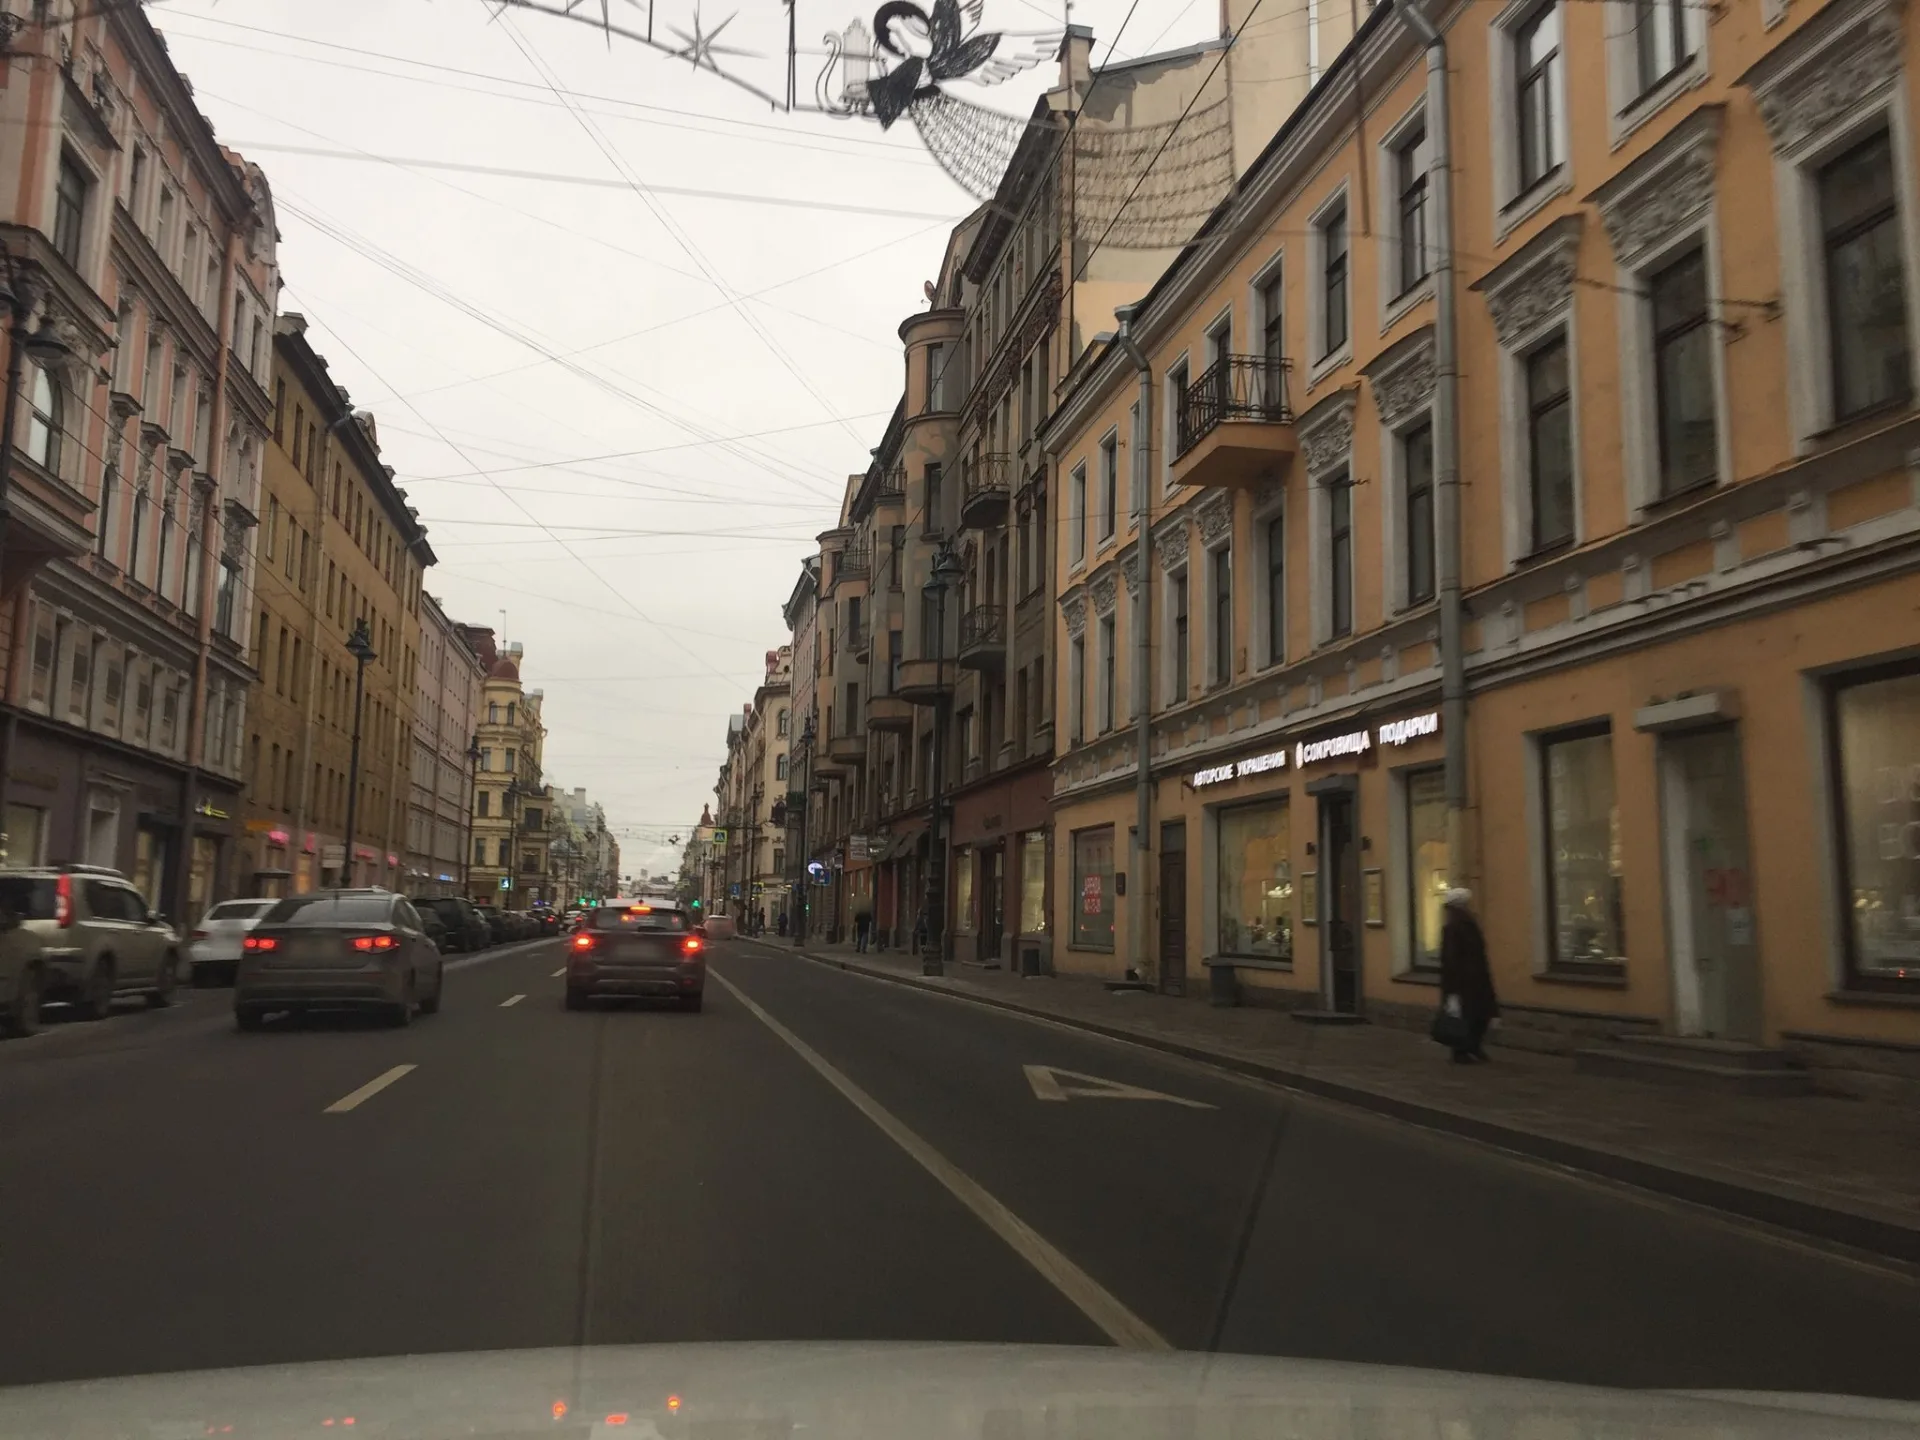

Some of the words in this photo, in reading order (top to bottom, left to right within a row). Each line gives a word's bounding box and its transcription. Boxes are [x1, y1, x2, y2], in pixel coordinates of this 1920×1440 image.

[1379, 712, 1438, 746] ПОДАРКИ
[1304, 730, 1371, 763] СОКРОВИЩА
[1193, 763, 1233, 787] АВТОРСКИЕ
[1237, 750, 1285, 777] УКРАШЕНИЯ
